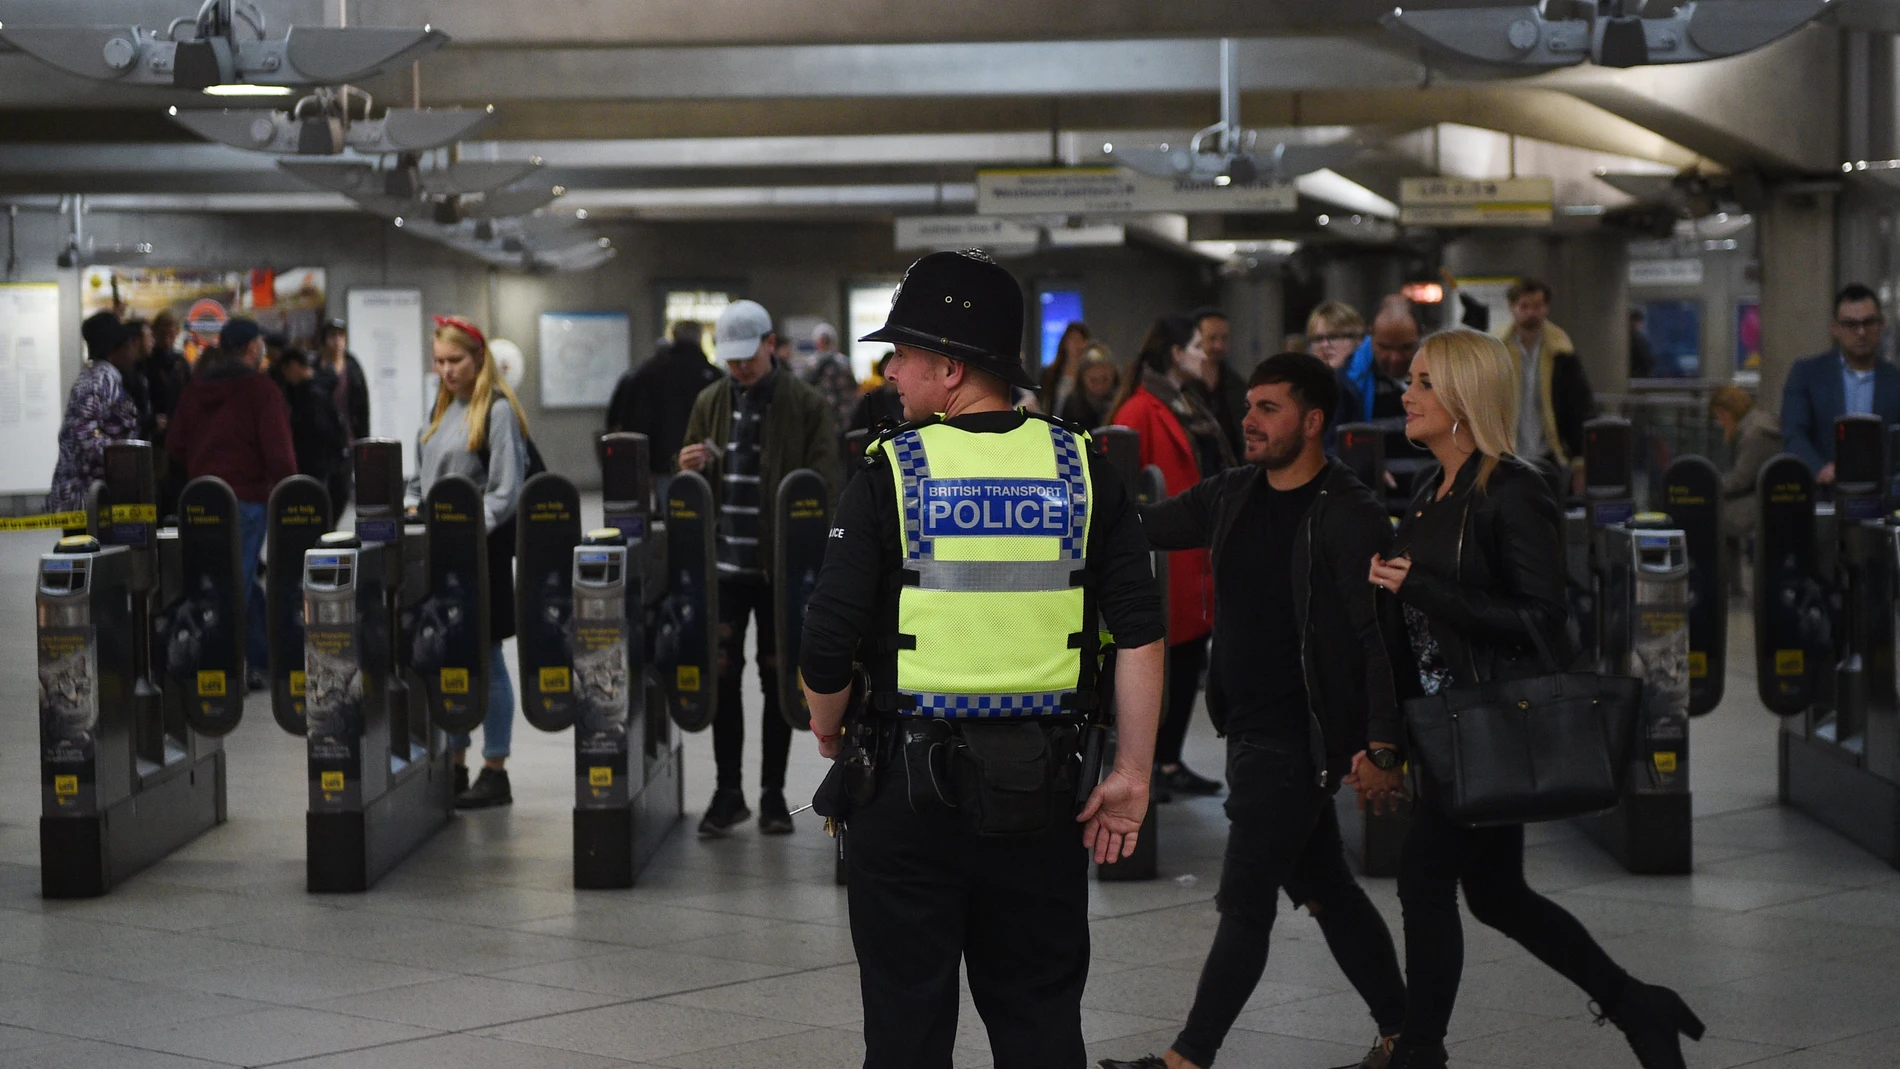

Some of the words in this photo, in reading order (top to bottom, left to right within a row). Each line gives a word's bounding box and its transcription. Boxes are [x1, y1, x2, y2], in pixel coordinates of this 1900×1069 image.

[929, 486, 981, 497] BRITISH
[984, 486, 1062, 497] TRANSPORT
[929, 500, 1063, 529] POLICE
